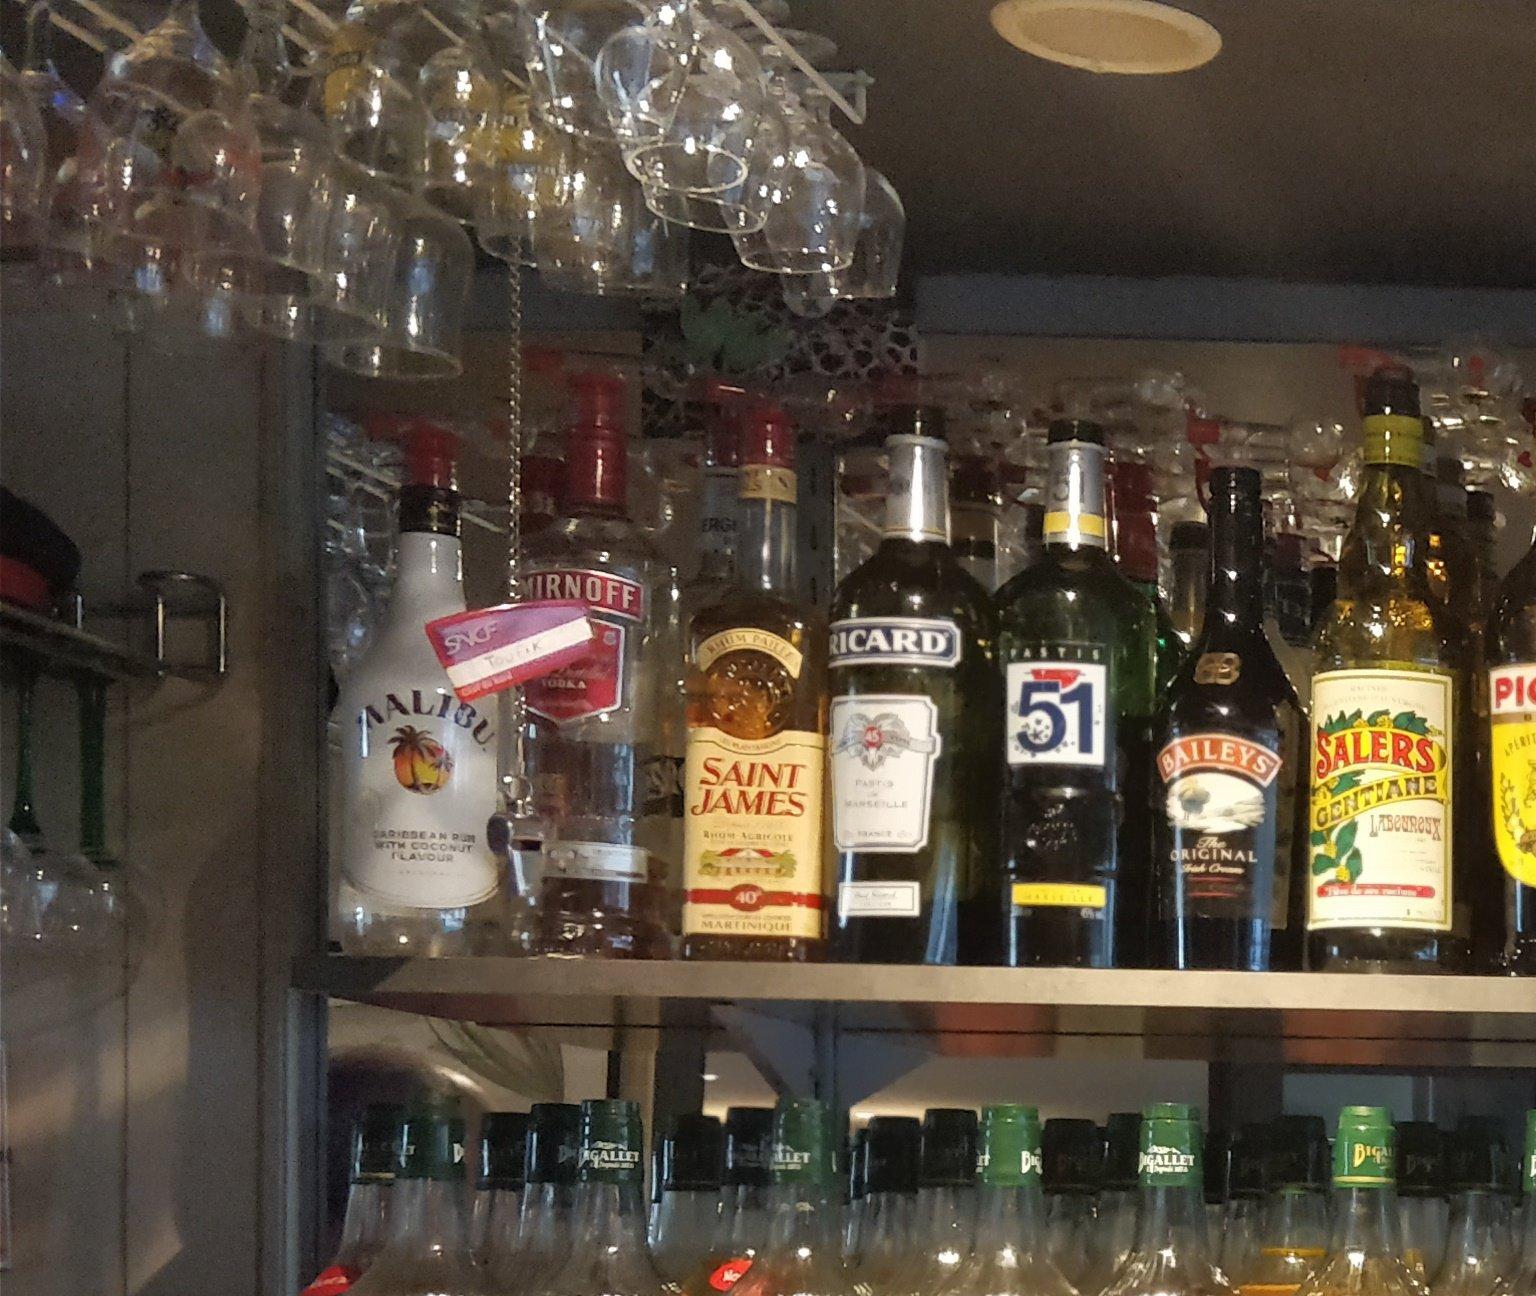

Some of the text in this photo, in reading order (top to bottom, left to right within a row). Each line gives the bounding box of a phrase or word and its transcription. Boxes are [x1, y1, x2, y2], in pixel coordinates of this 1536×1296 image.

[829, 627, 947, 655] RICARD
[1010, 646, 1100, 659] PASTIS
[357, 689, 495, 747] MALIBU
[1016, 680, 1094, 754] 51
[1161, 739, 1269, 774] BAILEYS
[1316, 729, 1436, 780] SALERS
[699, 756, 808, 789] SAINT
[690, 788, 809, 818] JAMES
[1315, 775, 1438, 828] GENTIANE
[1170, 849, 1258, 863] ORIGINAL
[1197, 836, 1226, 848] The
[701, 919, 792, 932] MARTINIQUE
